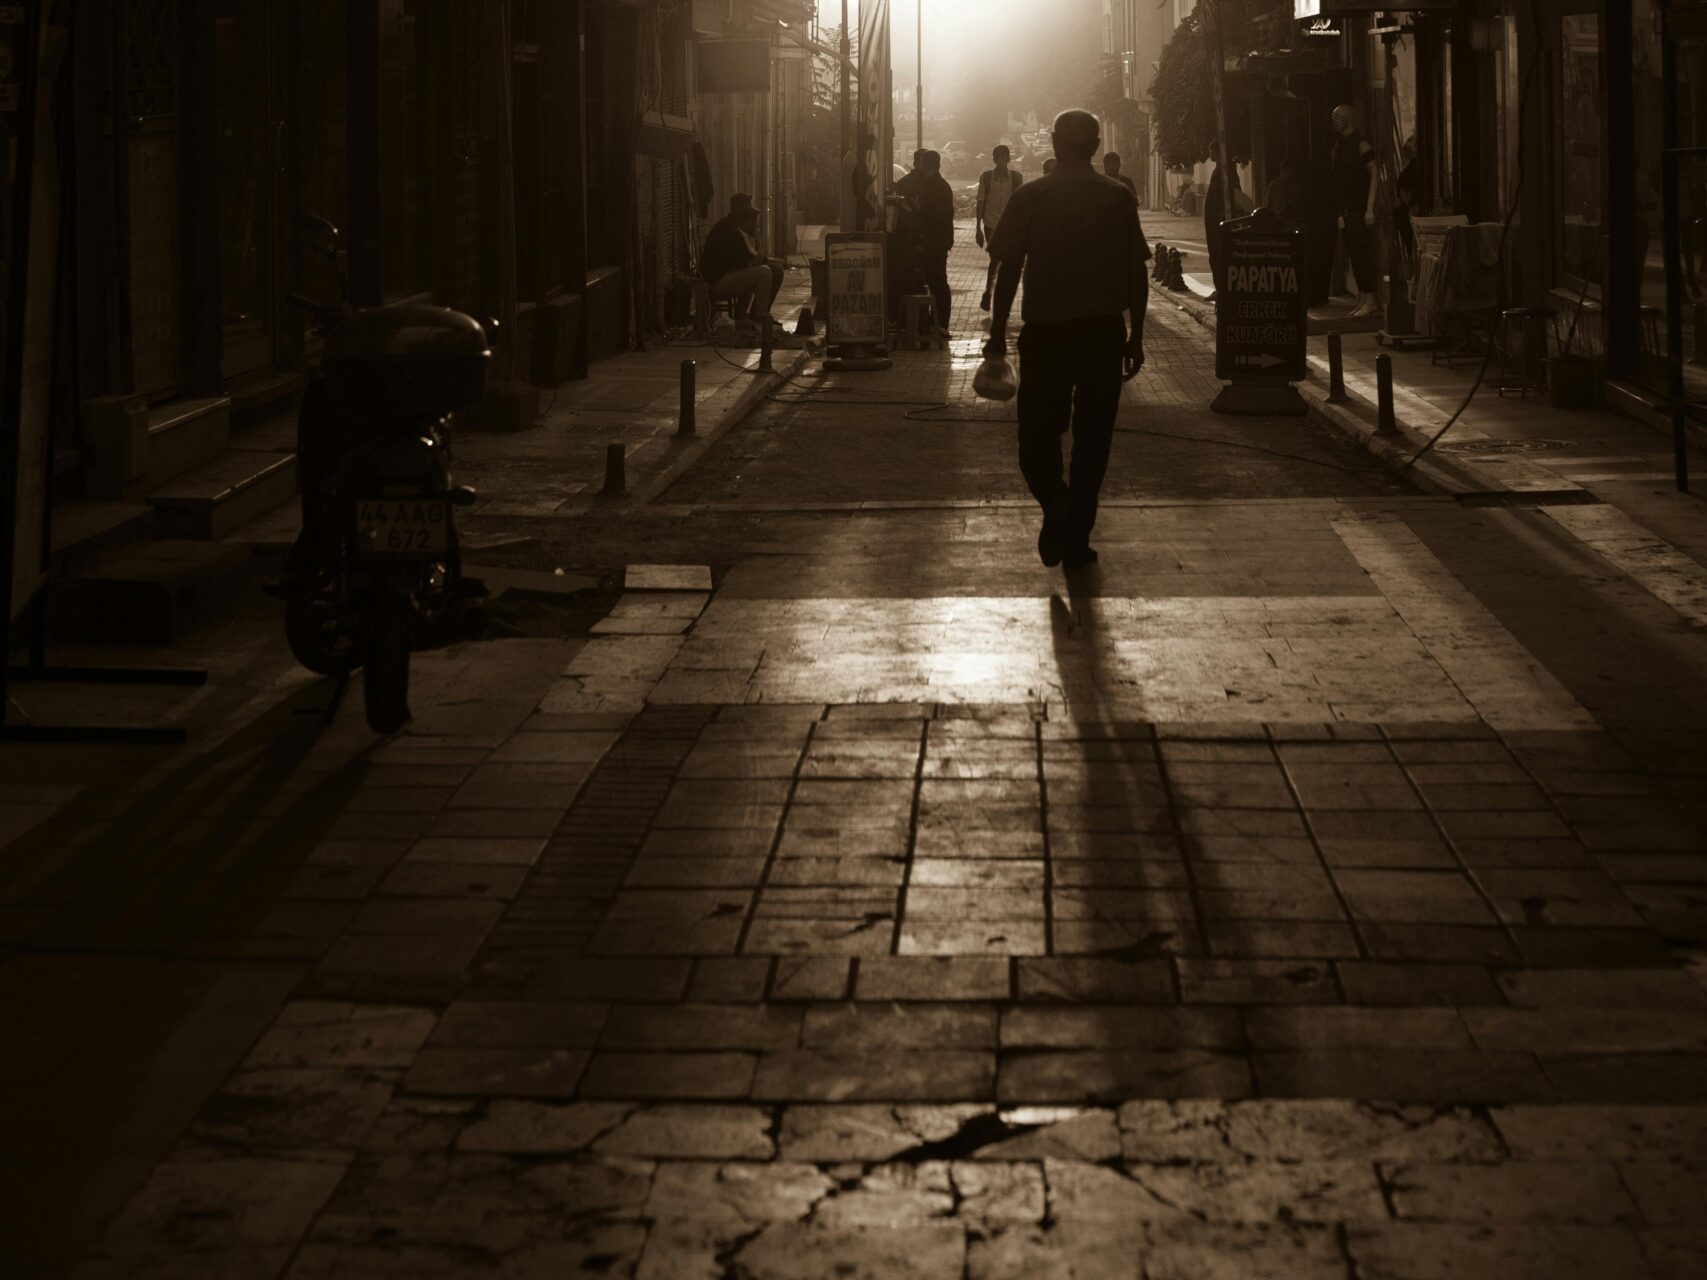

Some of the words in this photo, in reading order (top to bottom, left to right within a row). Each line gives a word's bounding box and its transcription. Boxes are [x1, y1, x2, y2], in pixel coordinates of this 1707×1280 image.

[831, 254, 881, 269] ERDOĞAN
[847, 270, 866, 292] AV
[1227, 265, 1299, 293] PAPATYA
[831, 293, 882, 315] PAZARI
[1239, 300, 1288, 318] ERKEK
[360, 503, 388, 523] 44
[394, 503, 444, 524] AAG
[387, 528, 430, 550] 672
